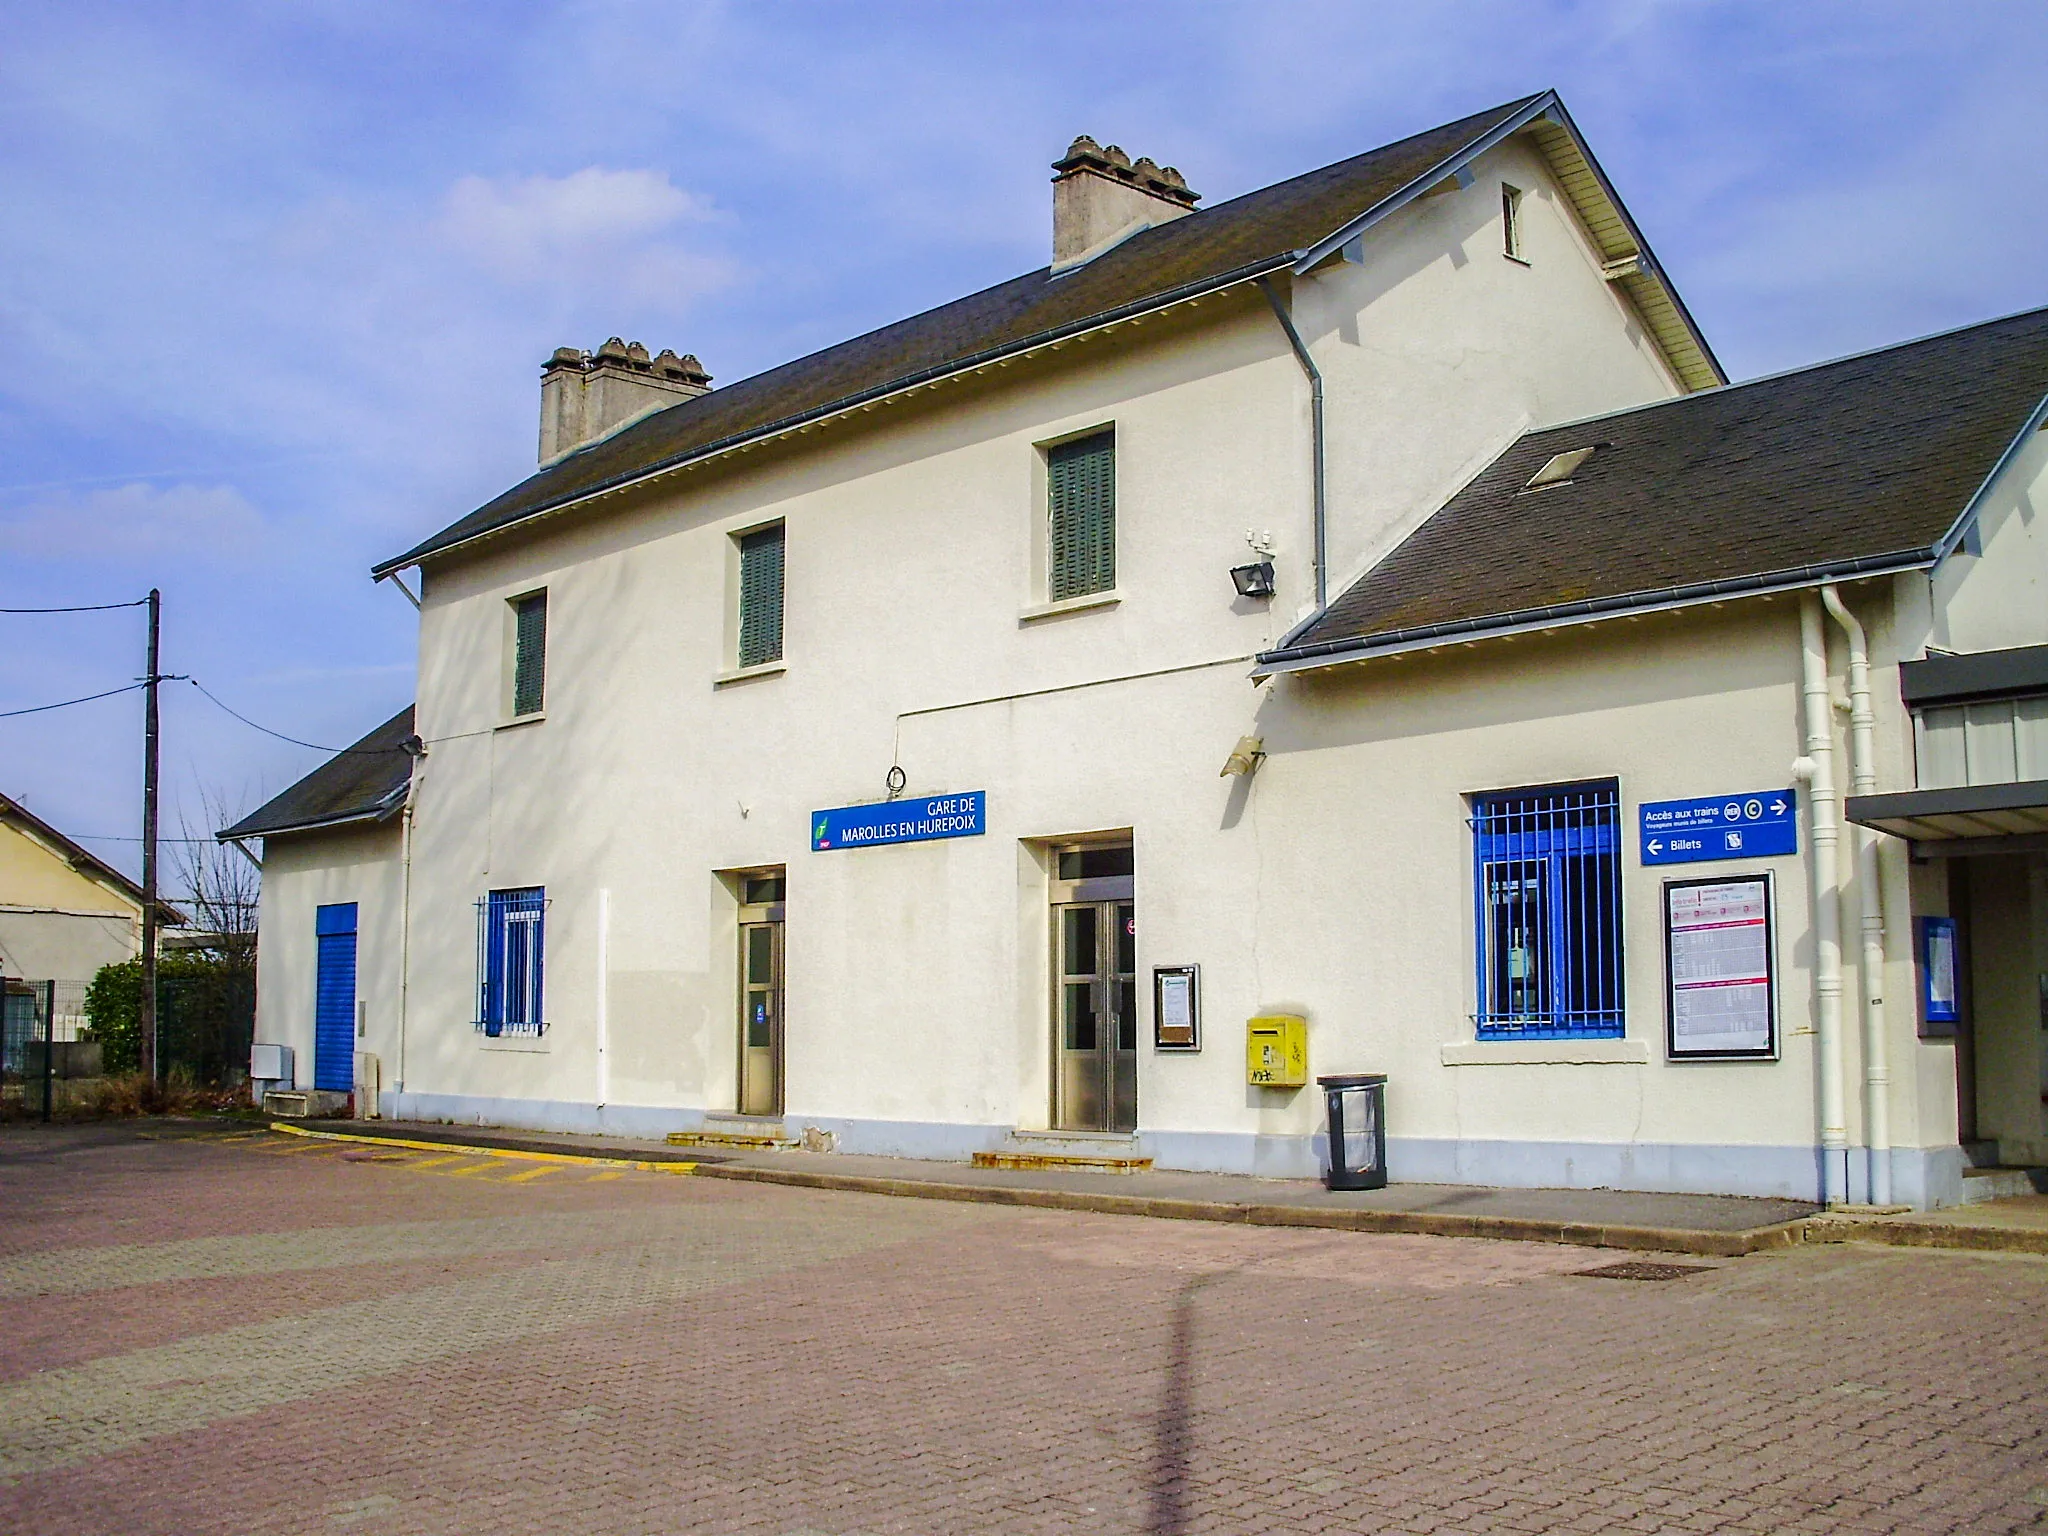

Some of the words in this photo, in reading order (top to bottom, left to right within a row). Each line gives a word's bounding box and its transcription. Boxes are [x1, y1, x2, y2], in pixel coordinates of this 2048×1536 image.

[928, 799, 956, 816] GARE
[960, 797, 976, 812] DE
[1645, 811, 1672, 821] Accès
[1675, 810, 1692, 818] aux
[1693, 807, 1719, 817] trains
[842, 823, 897, 842] MAROLLES
[900, 821, 915, 837] EN
[918, 815, 976, 834] HUREPOIX
[1670, 840, 1701, 851] Billets
